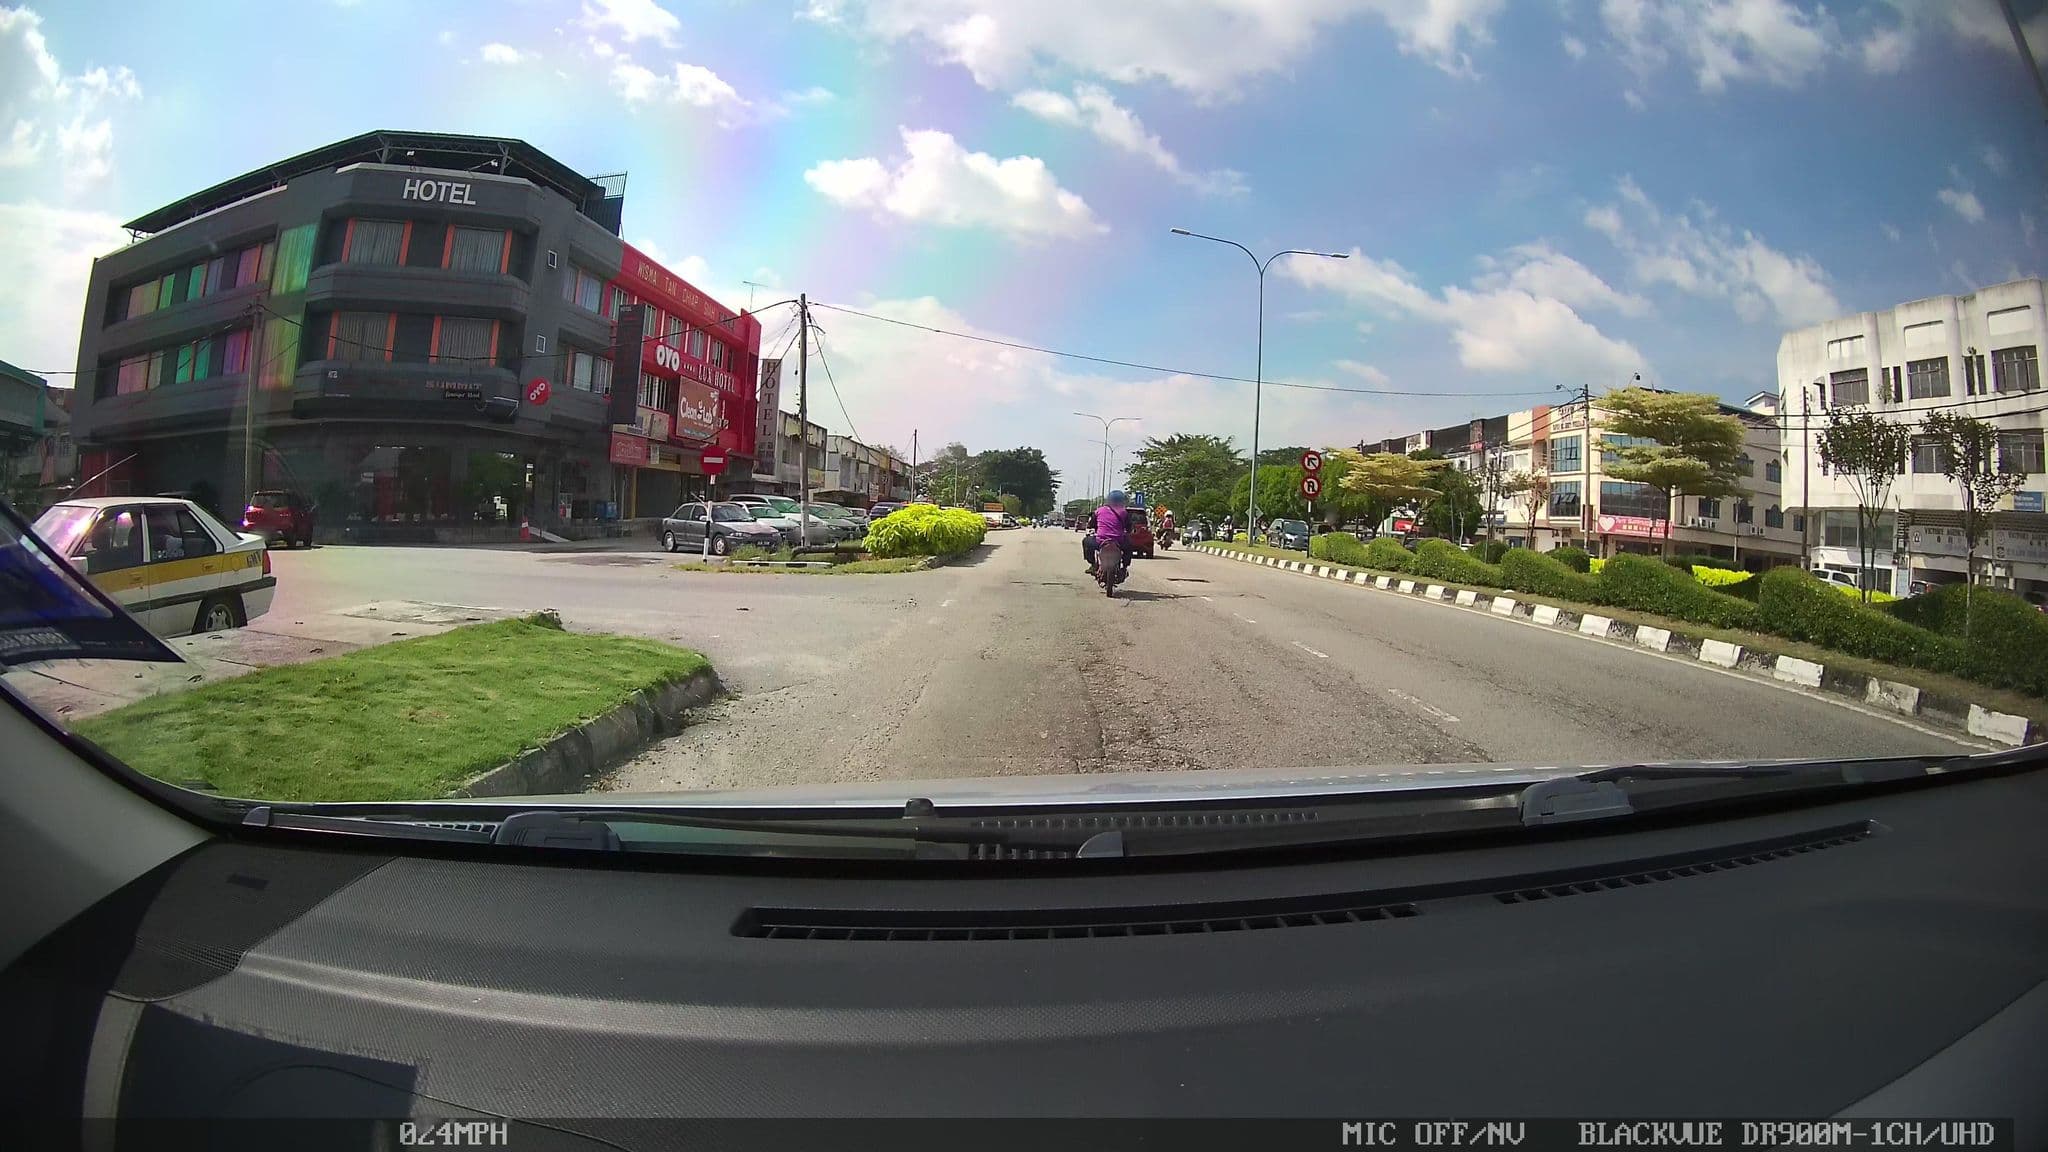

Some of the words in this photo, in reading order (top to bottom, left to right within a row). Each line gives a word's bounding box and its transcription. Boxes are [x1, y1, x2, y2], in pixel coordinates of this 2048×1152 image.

[403, 178, 476, 206] HOTEL
[664, 276, 678, 297] TAN
[656, 344, 680, 372] OYO
[529, 382, 546, 401] OYO
[698, 364, 713, 384] LUX
[714, 371, 736, 393] HOTEL
[762, 361, 777, 437] HOTEL
